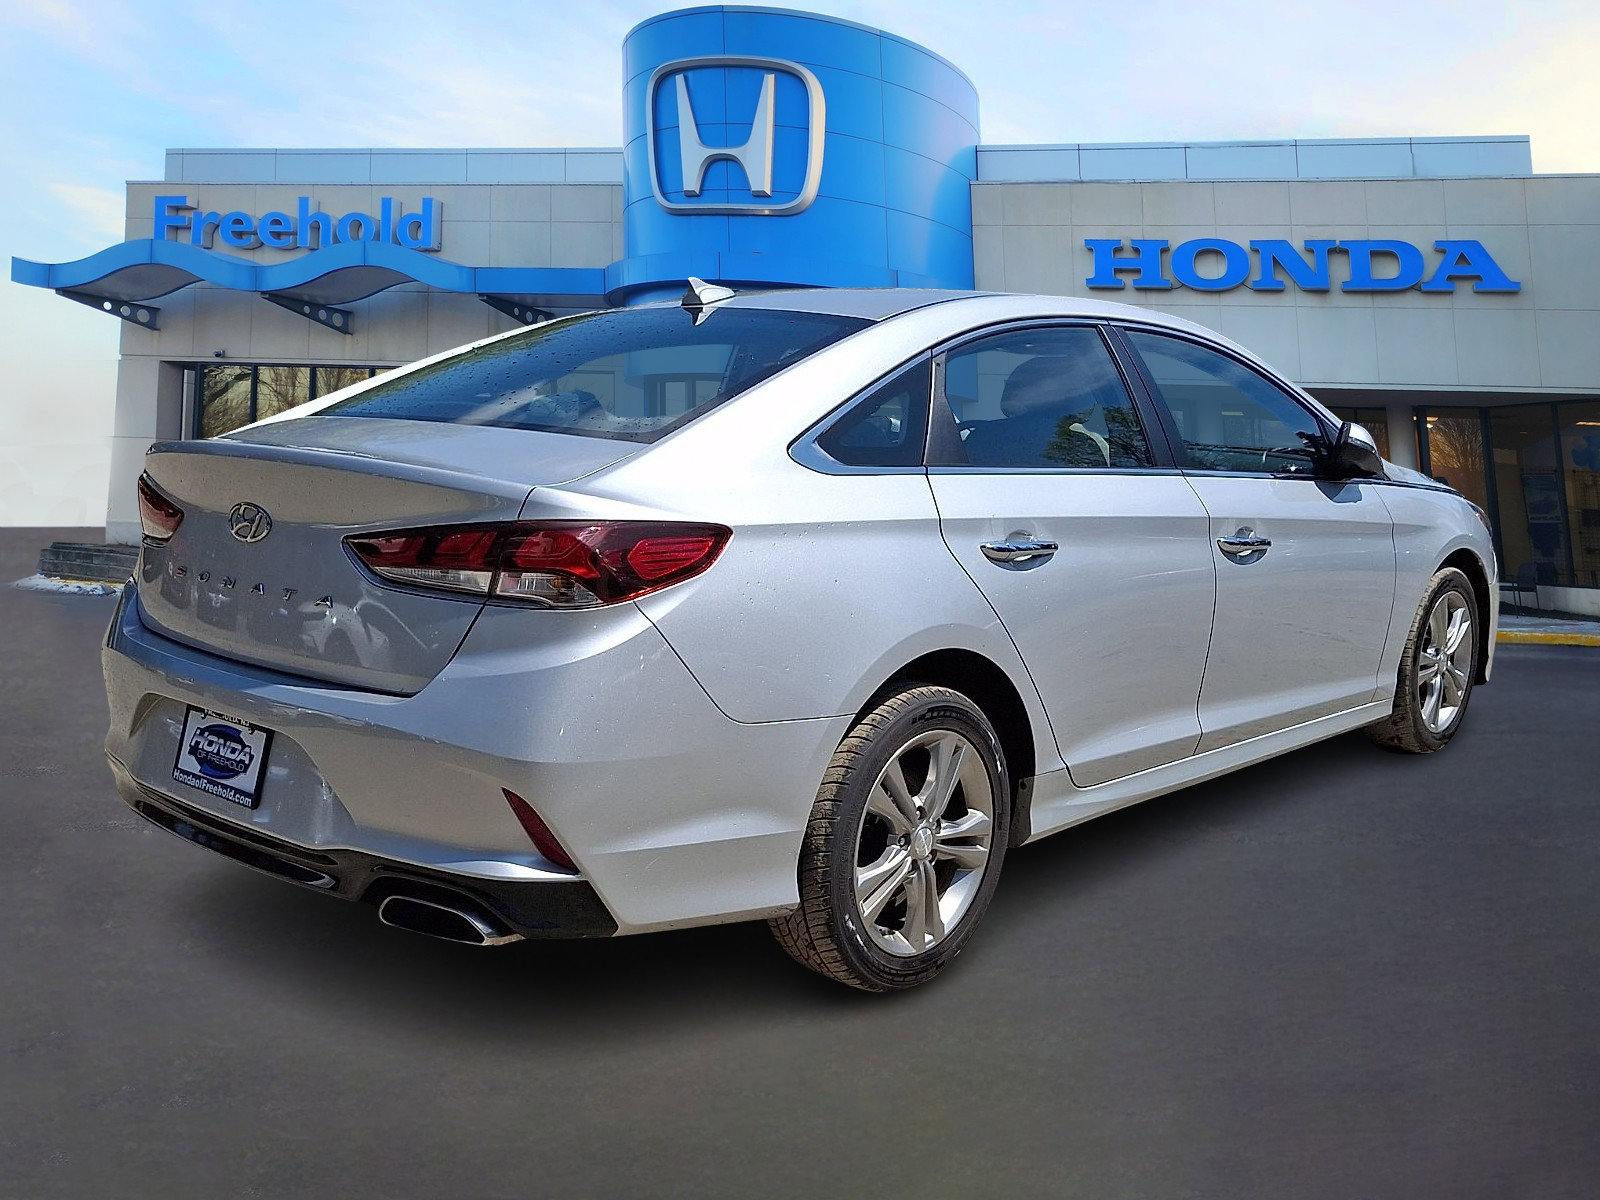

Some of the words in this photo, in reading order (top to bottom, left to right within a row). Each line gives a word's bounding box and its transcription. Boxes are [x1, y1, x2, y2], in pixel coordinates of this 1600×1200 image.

[154, 195, 438, 249] Freehold
[1084, 238, 1521, 293] HONDA
[174, 565, 333, 608] SONATA
[191, 729, 250, 764] HONDA
[197, 749, 207, 759] OF
[207, 753, 245, 772] FREEHOLD
[173, 769, 252, 807] HondaofFreehold.com
